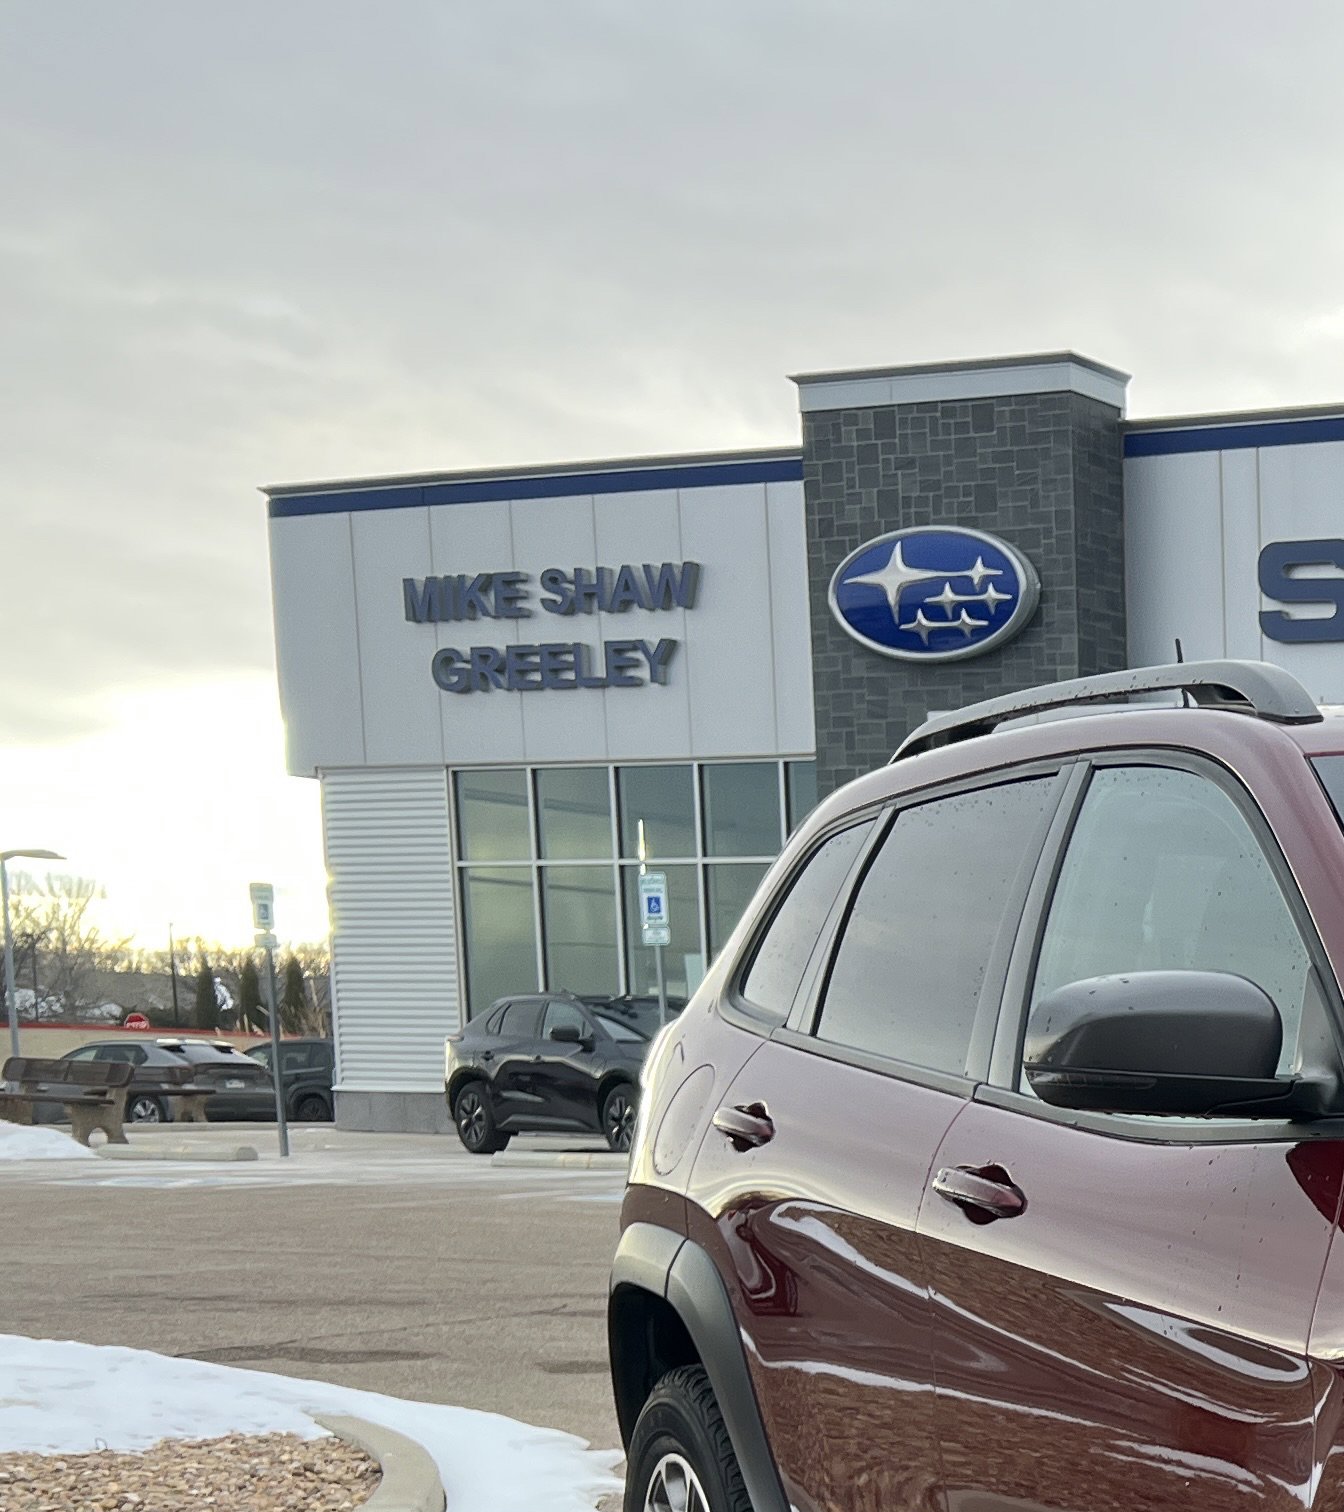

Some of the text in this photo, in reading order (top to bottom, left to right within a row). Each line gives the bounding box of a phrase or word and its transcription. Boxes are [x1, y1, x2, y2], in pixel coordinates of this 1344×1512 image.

[402, 561, 699, 623] MIKE SHAW
[431, 638, 677, 694] GREELEY
